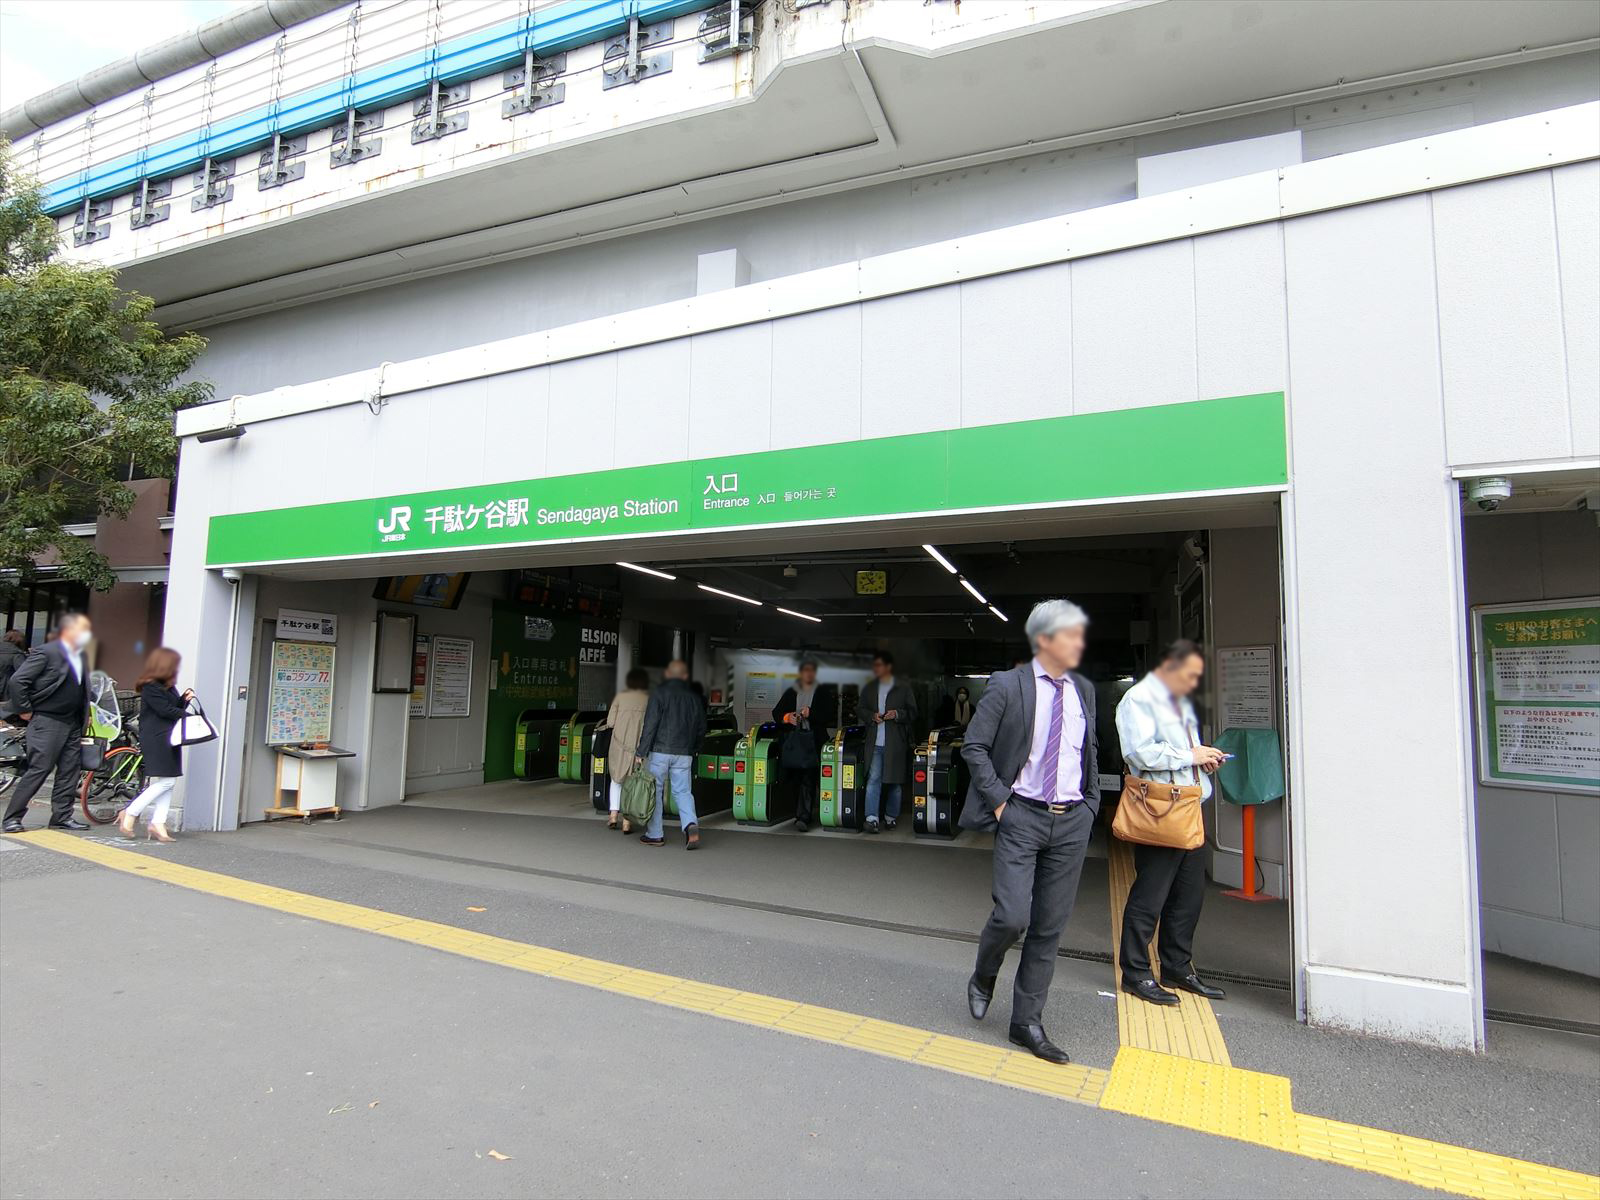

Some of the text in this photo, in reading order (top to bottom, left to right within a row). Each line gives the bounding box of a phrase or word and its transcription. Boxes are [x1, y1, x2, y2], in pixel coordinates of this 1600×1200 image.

[704, 473, 738, 495] 入口
[703, 487, 837, 510] Entrance 入口 들어가는 곳
[378, 506, 412, 534] JR
[536, 498, 679, 525] Sendagaya Station
[514, 672, 559, 685] Entrance
[736, 741, 748, 749] IC
[822, 745, 835, 753] IC
